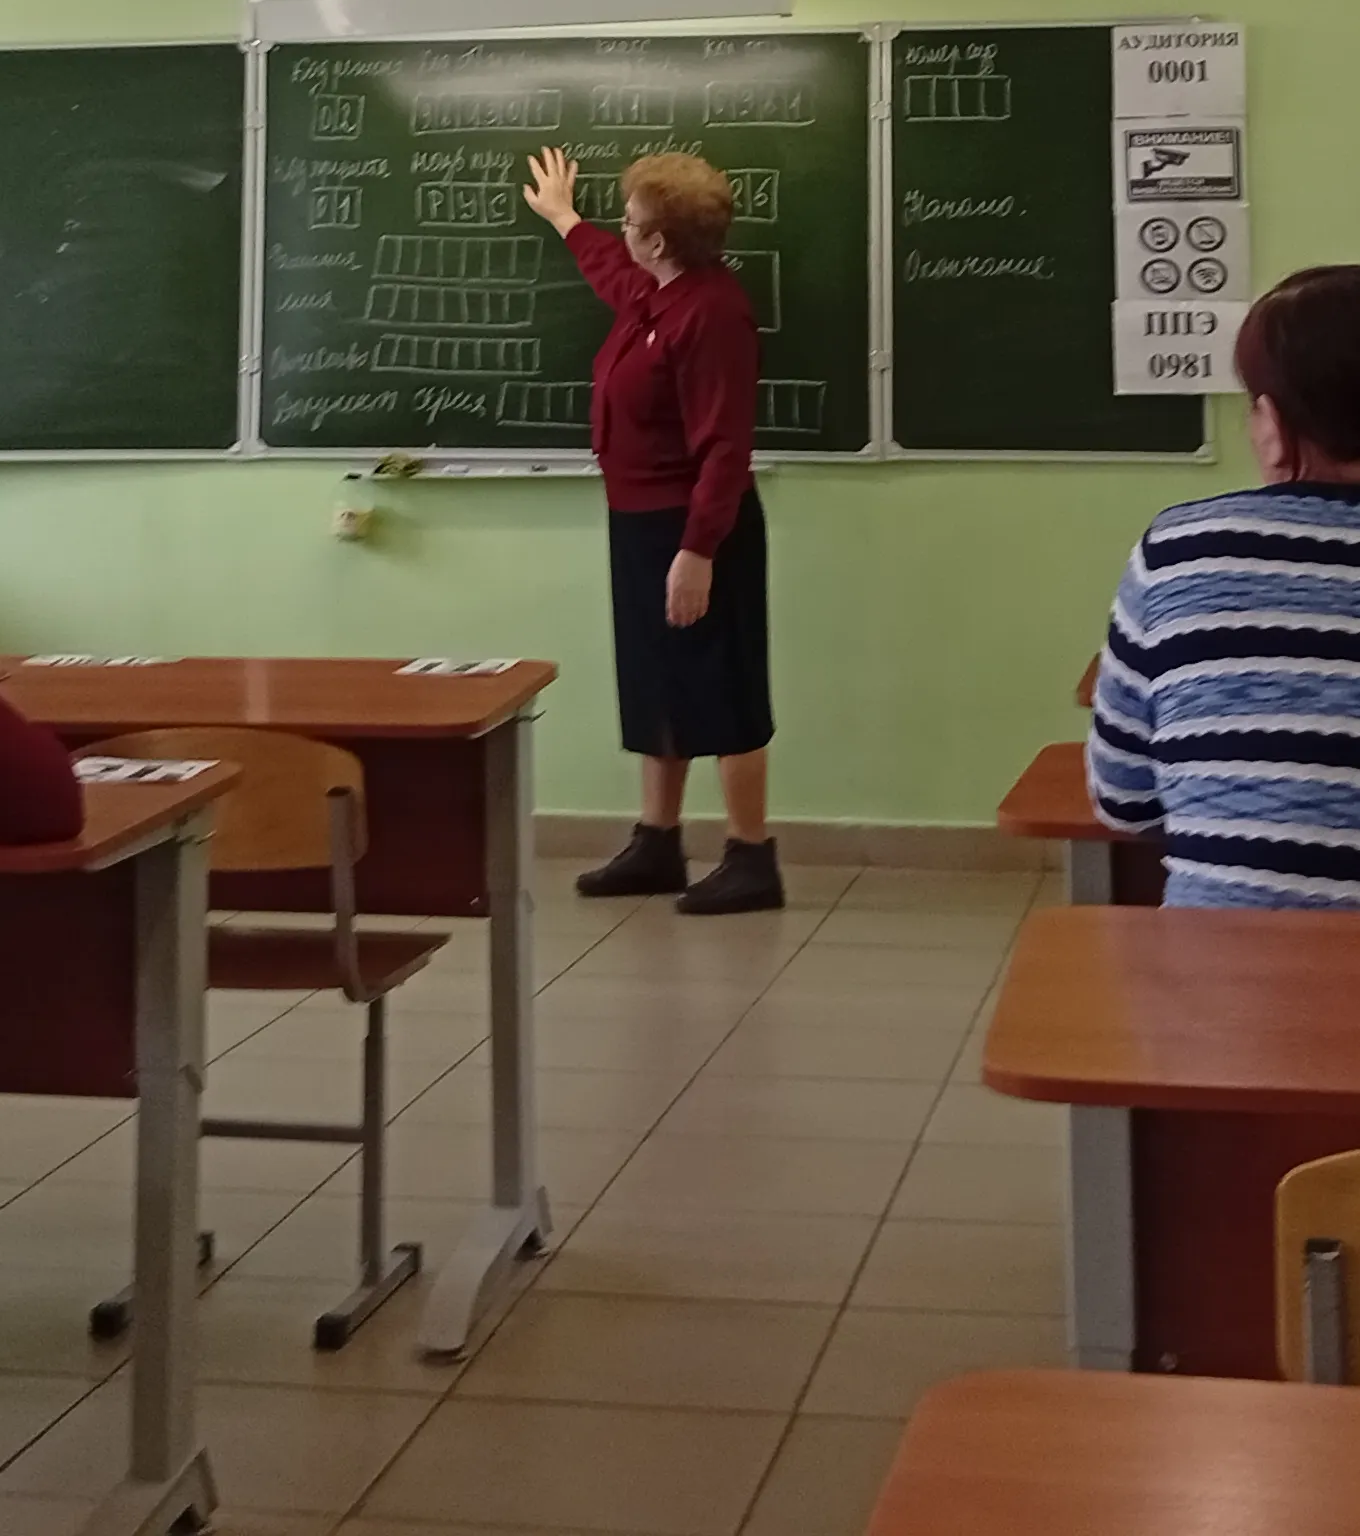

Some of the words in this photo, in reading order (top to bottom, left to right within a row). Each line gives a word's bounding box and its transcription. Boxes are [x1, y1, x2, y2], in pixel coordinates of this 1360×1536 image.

[1118, 31, 1240, 51] АУДИТОРИЯ
[1148, 58, 1210, 83] 0001
[1131, 131, 1232, 147] ВНИМАНИЕ!
[1144, 311, 1219, 336] ППЭ
[1149, 353, 1213, 379] 0981
